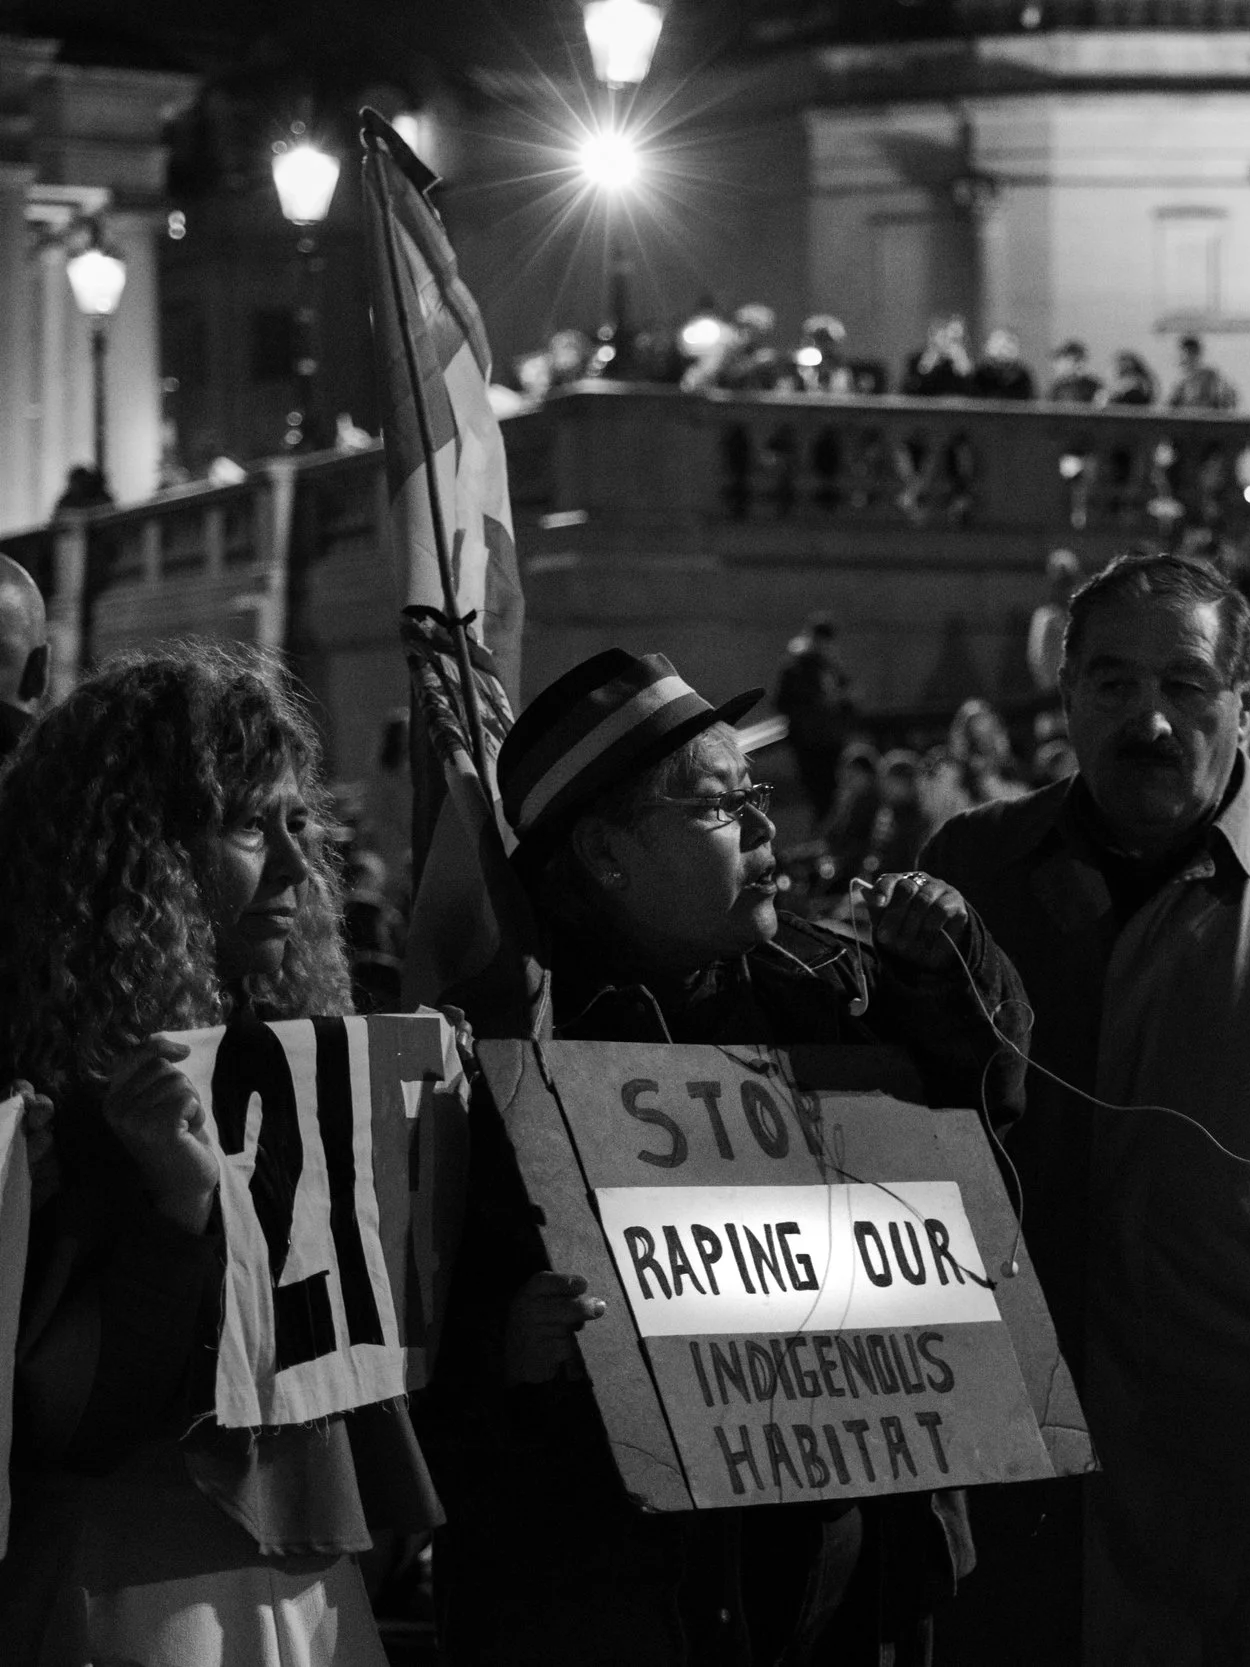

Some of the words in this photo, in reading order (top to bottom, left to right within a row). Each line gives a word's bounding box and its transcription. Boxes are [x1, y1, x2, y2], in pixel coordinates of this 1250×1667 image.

[621, 1078, 825, 1169] STOP
[623, 1222, 820, 1300] RAPING
[854, 1219, 966, 1288] OUR
[689, 1332, 955, 1408] INDIGENOUS
[714, 1411, 949, 1494] HABITAT
